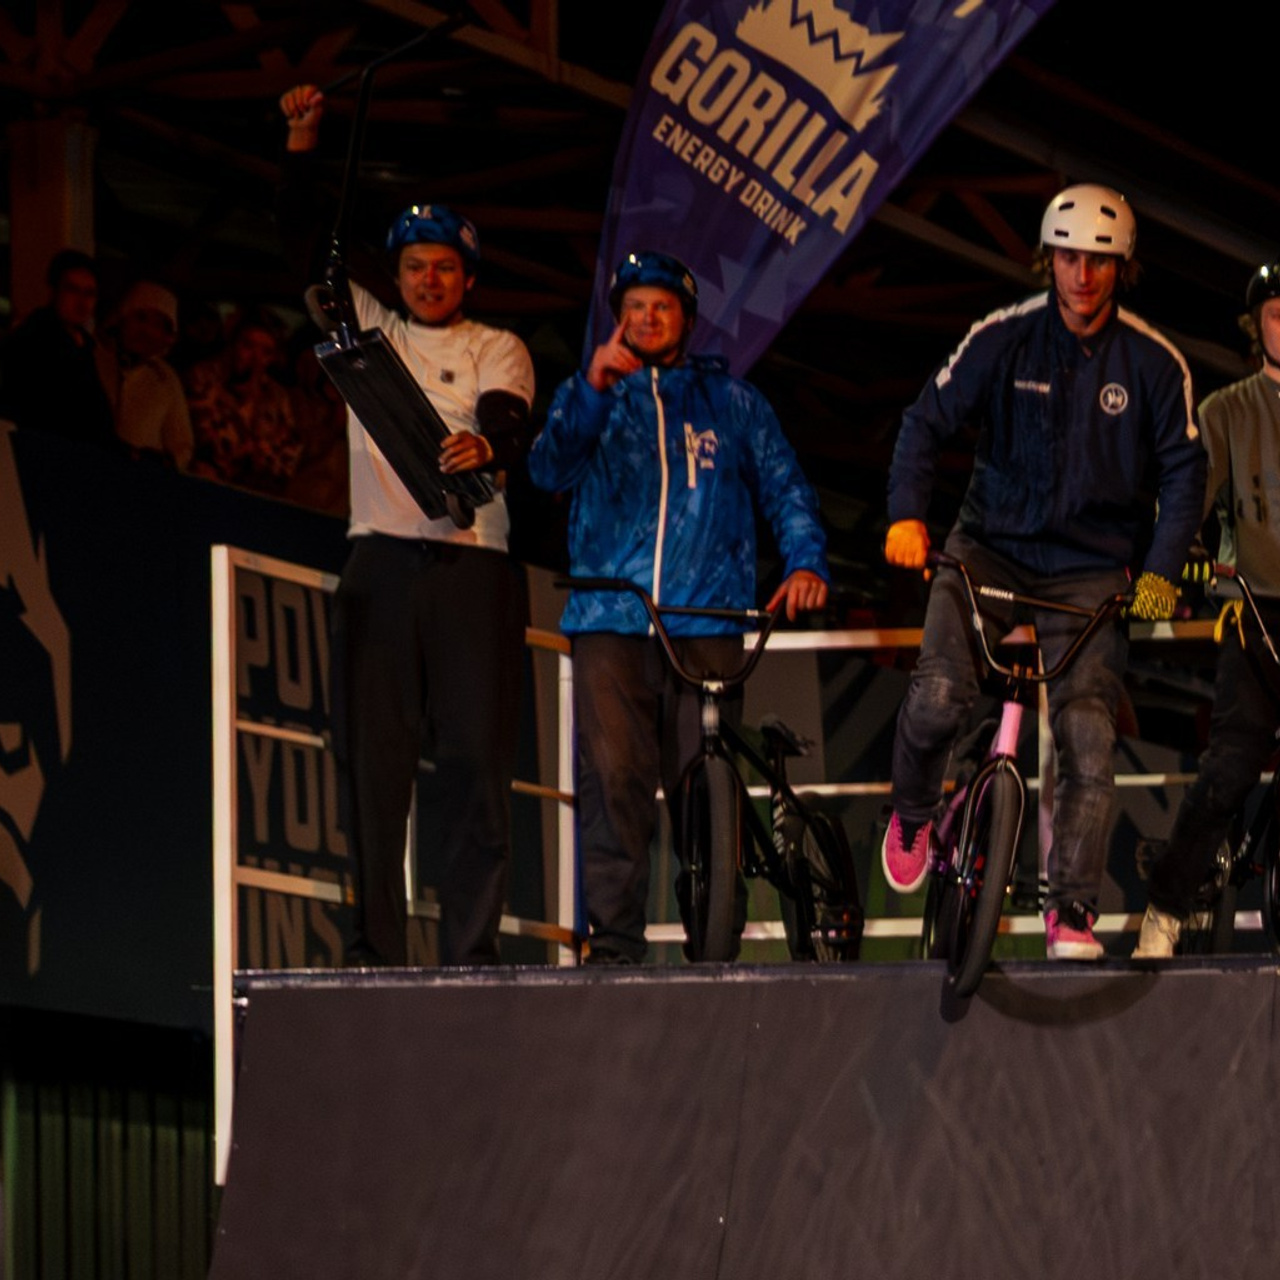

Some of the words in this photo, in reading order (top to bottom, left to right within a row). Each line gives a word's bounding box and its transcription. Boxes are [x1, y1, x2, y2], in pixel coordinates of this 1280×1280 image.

[650, 21, 880, 236] GORILLA
[652, 113, 746, 194] ENERGY
[739, 178, 808, 247] DRINK
